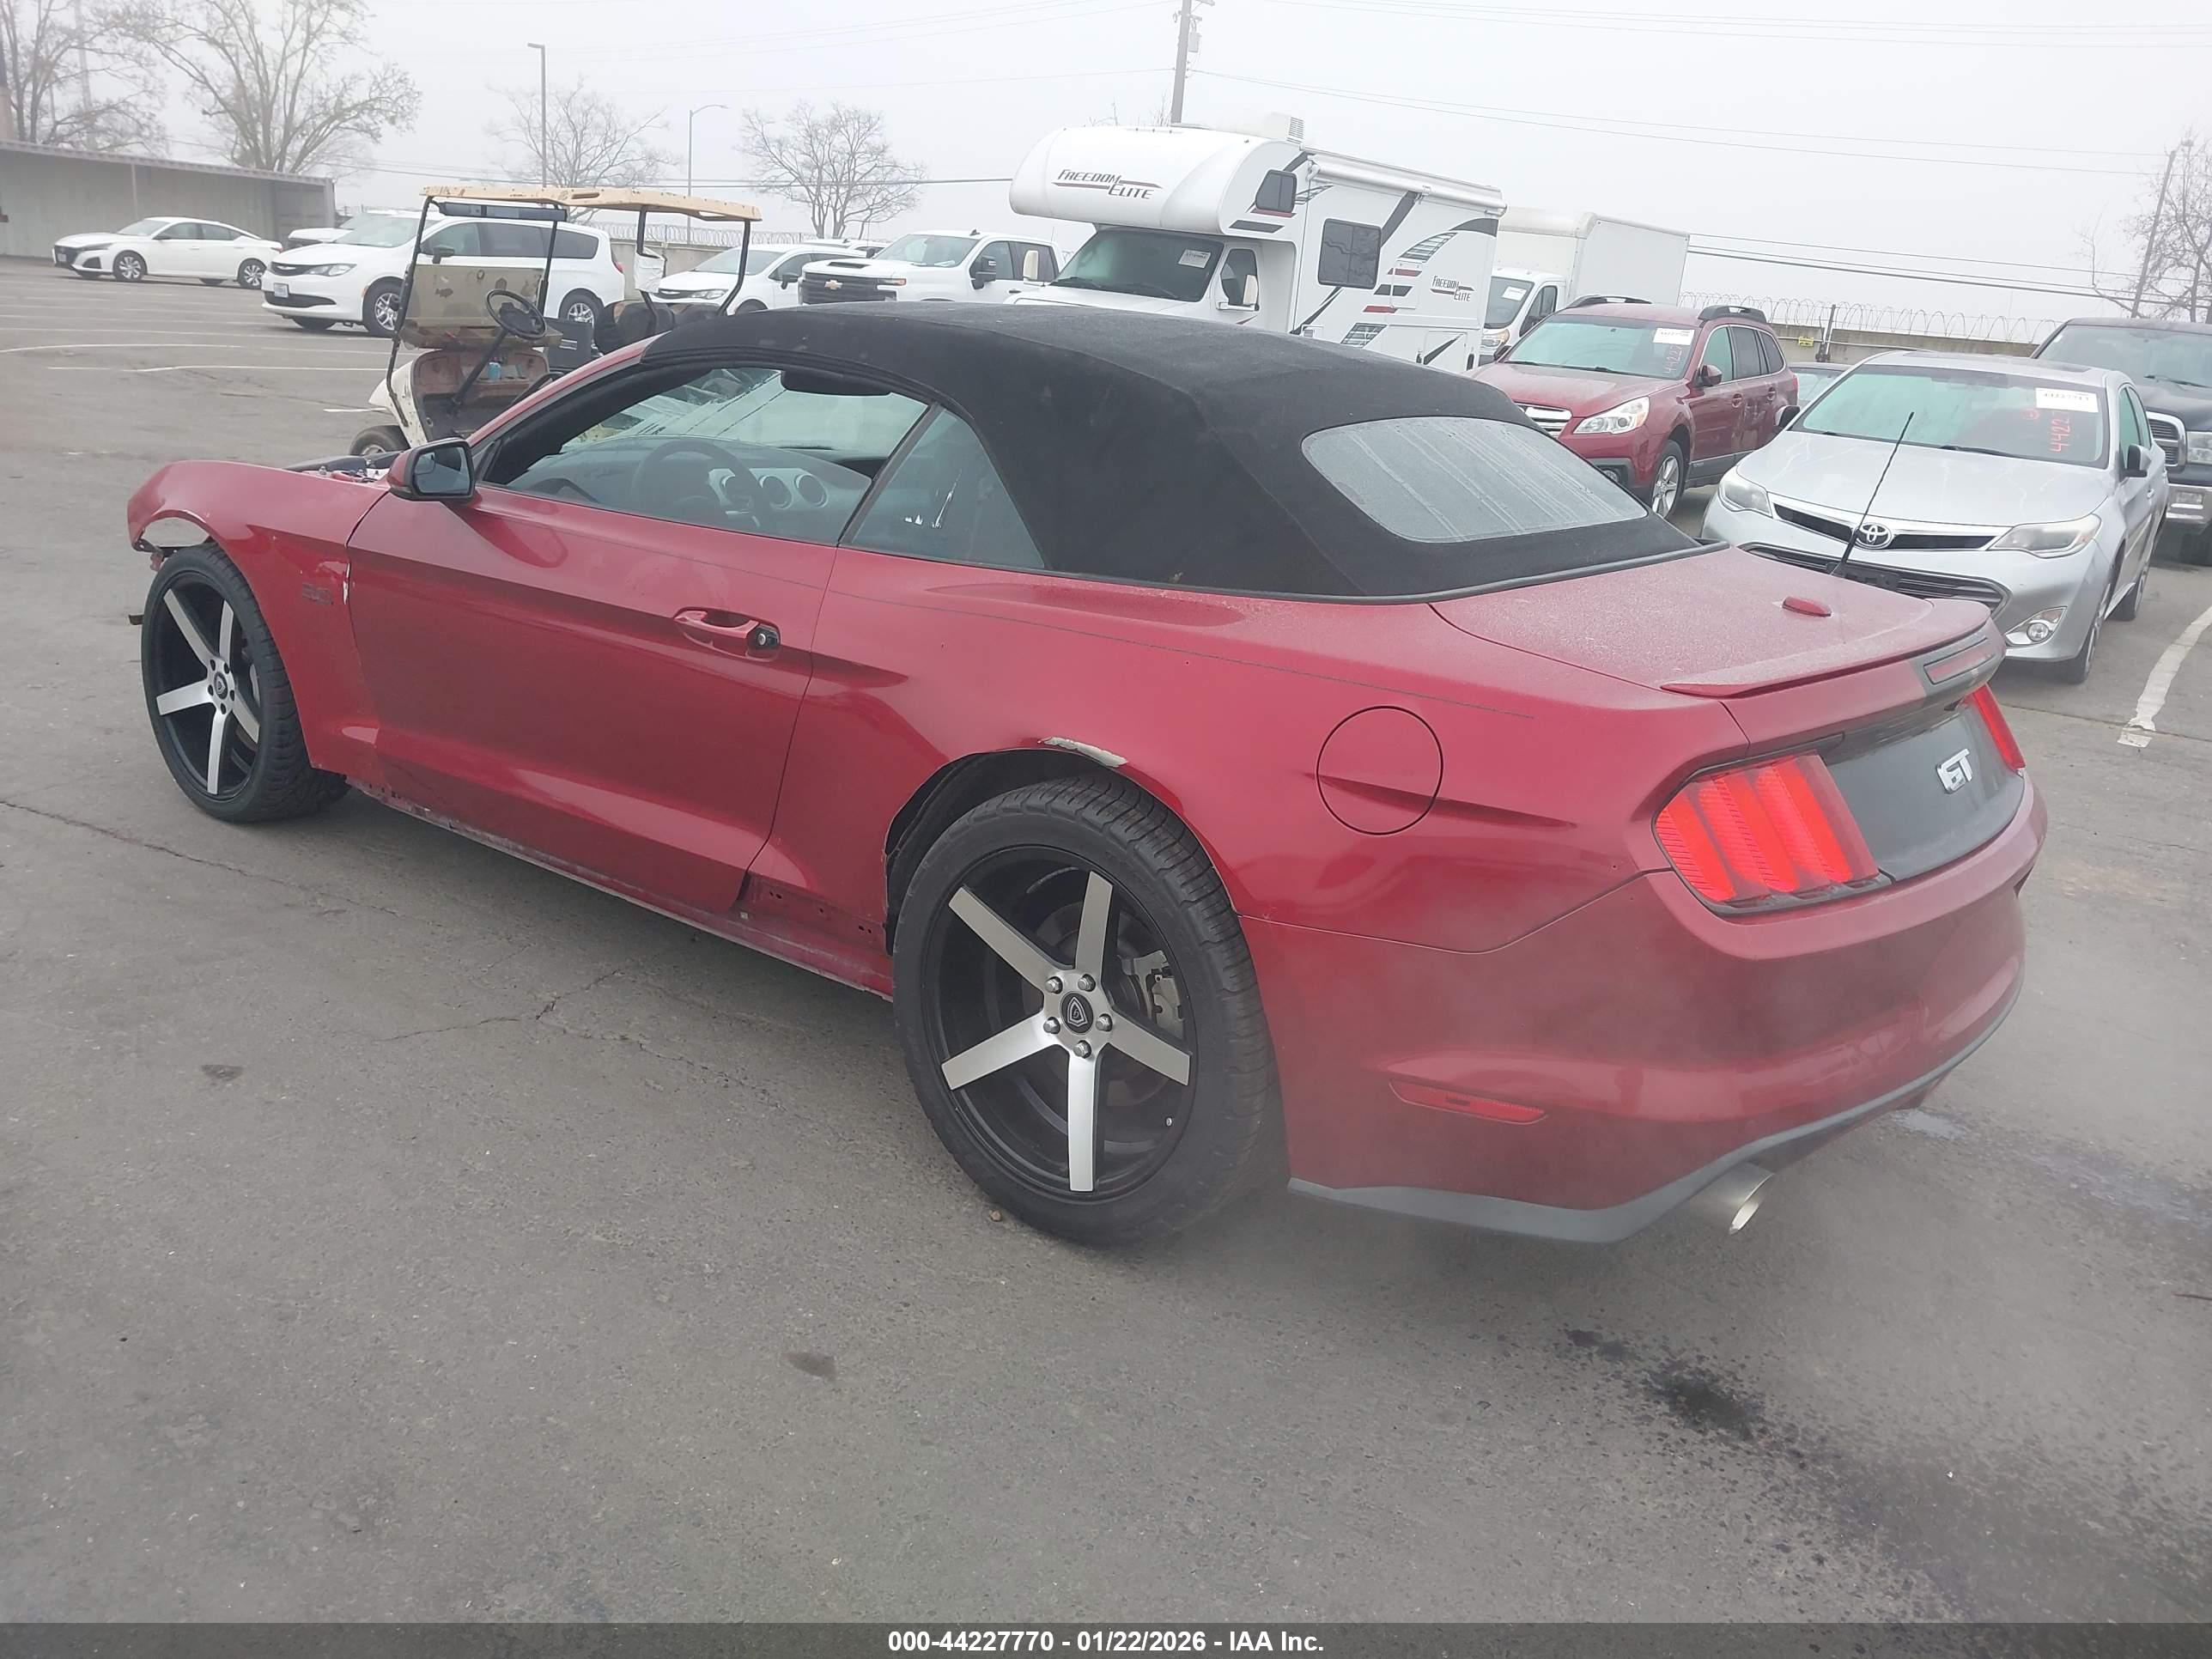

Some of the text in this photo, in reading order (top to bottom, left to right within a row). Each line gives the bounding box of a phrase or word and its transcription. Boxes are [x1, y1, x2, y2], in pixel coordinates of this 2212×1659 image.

[1057, 169, 1121, 184] FREEDOM
[1108, 184, 1155, 199] ELITE
[1936, 748, 1972, 792] GT
